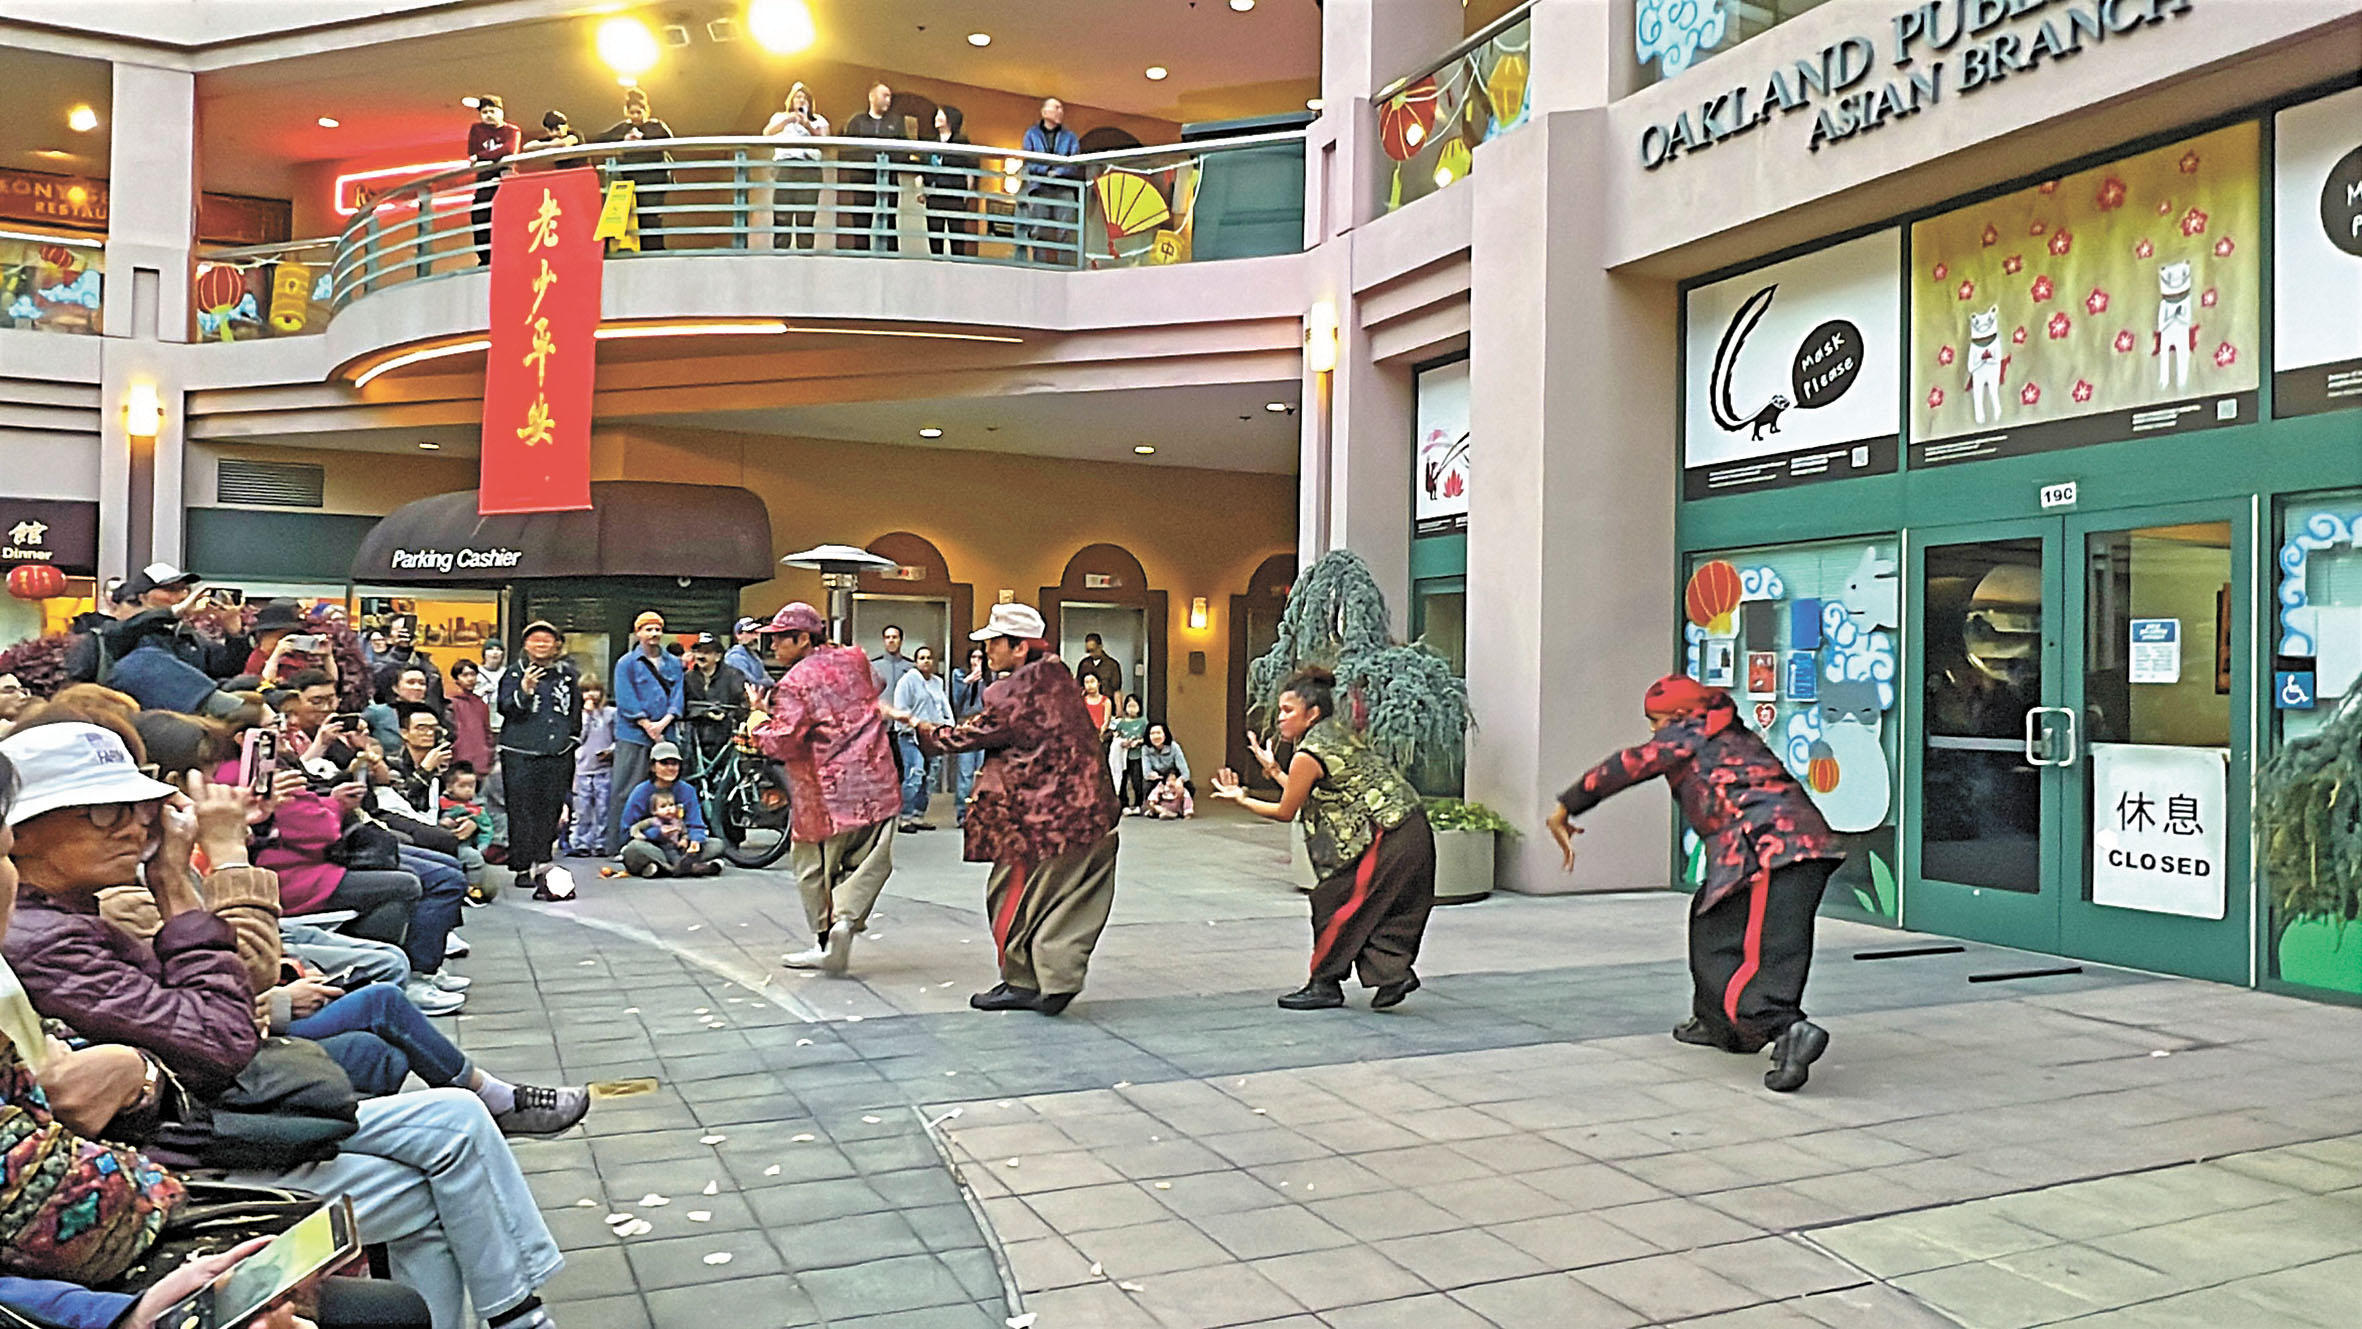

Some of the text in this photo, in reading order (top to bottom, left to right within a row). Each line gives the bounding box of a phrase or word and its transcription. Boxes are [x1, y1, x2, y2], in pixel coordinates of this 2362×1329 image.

[1641, 36, 1874, 169] OAKLAND
[1808, 63, 1943, 153] ASIAN
[2044, 487, 2073, 503] 19C
[2, 547, 53, 560] Dinner
[391, 548, 522, 573] Parking Cashier
[2117, 790, 2204, 835] 休息
[2108, 849, 2211, 877] CLOSED
